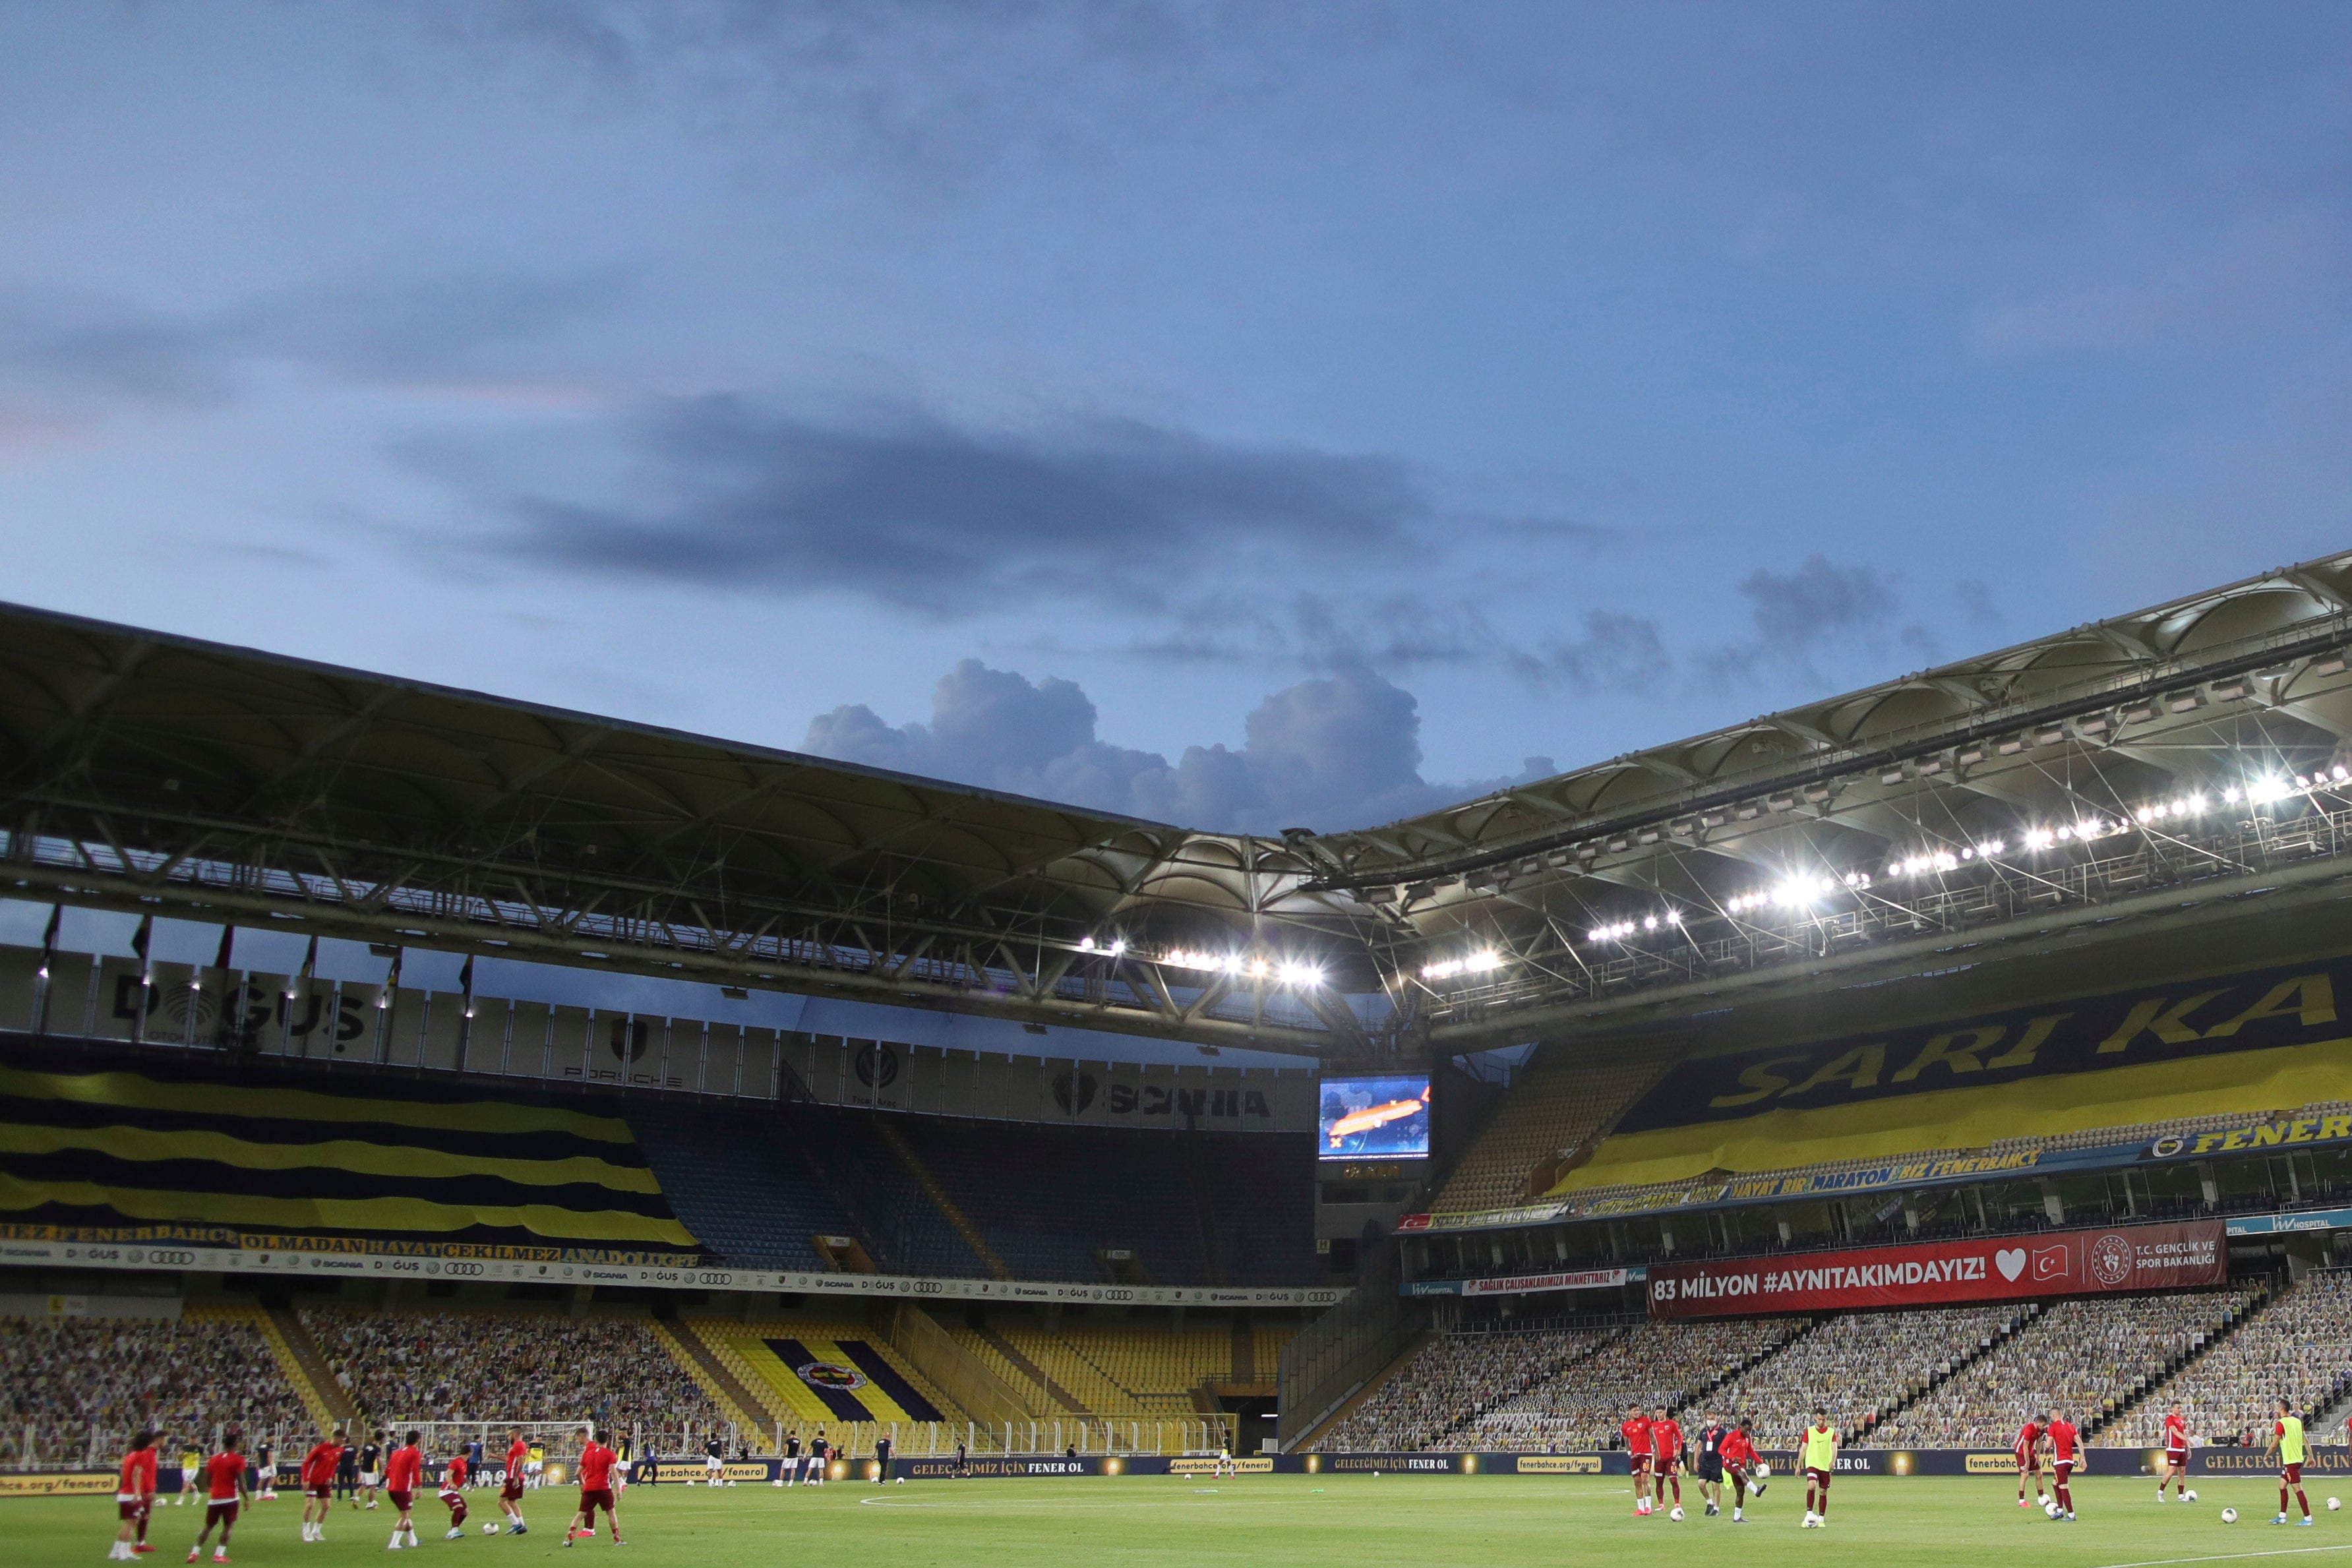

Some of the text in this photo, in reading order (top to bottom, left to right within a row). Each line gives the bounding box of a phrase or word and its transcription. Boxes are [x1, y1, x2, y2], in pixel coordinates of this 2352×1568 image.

[1708, 973, 2338, 1108] SARI KA
[564, 1066, 682, 1087] PORSCHE
[1102, 1083, 1271, 1118] SCANIA
[1731, 1180, 1779, 1197] HAYAT
[1810, 1166, 1894, 1191] MARATON
[2293, 1219, 2330, 1230] HOSPITAL
[245, 1235, 364, 1252] OLMADAN
[2136, 1240, 2215, 1255] T.C. GENÇLİK VE
[2136, 1253, 2216, 1269] SPOR BAKANLIĞI
[1479, 1279, 1503, 1292] SAĞLIK
[1505, 1275, 1563, 1290] ÇALIŞANLARIMIZA
[1565, 1272, 1610, 1286] MİNNETTARIZ
[1654, 1257, 1986, 1300] 83 MİLYON #AYNITAKIMDAYIZ!
[1000, 1461, 1027, 1476] İÇİN
[1028, 1462, 1066, 1473] FENER
[1068, 1462, 1084, 1473] OL
[1335, 1457, 1449, 1471] GELECEĞİMİZ İÇİN FENER OL
[1854, 1458, 1870, 1470] OL
[2316, 1451, 2350, 1472] İÇİN
